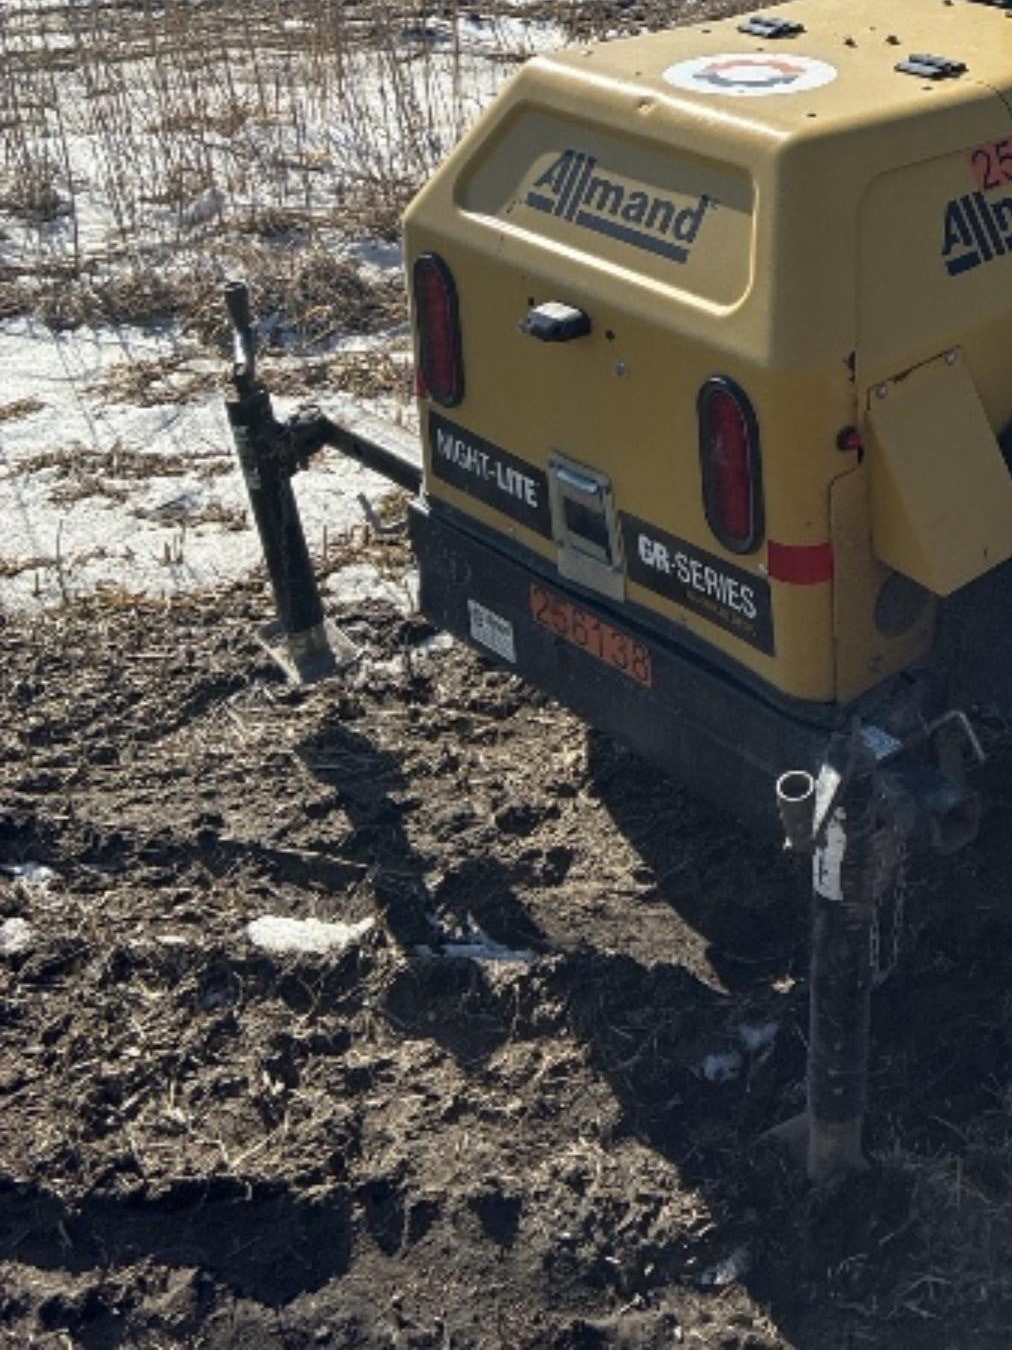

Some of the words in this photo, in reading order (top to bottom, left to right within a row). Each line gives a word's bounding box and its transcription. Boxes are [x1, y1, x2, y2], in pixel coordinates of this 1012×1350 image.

[532, 150, 708, 243] Allmand
[638, 534, 758, 619] GR-SERIES
[532, 584, 649, 683] 256138
